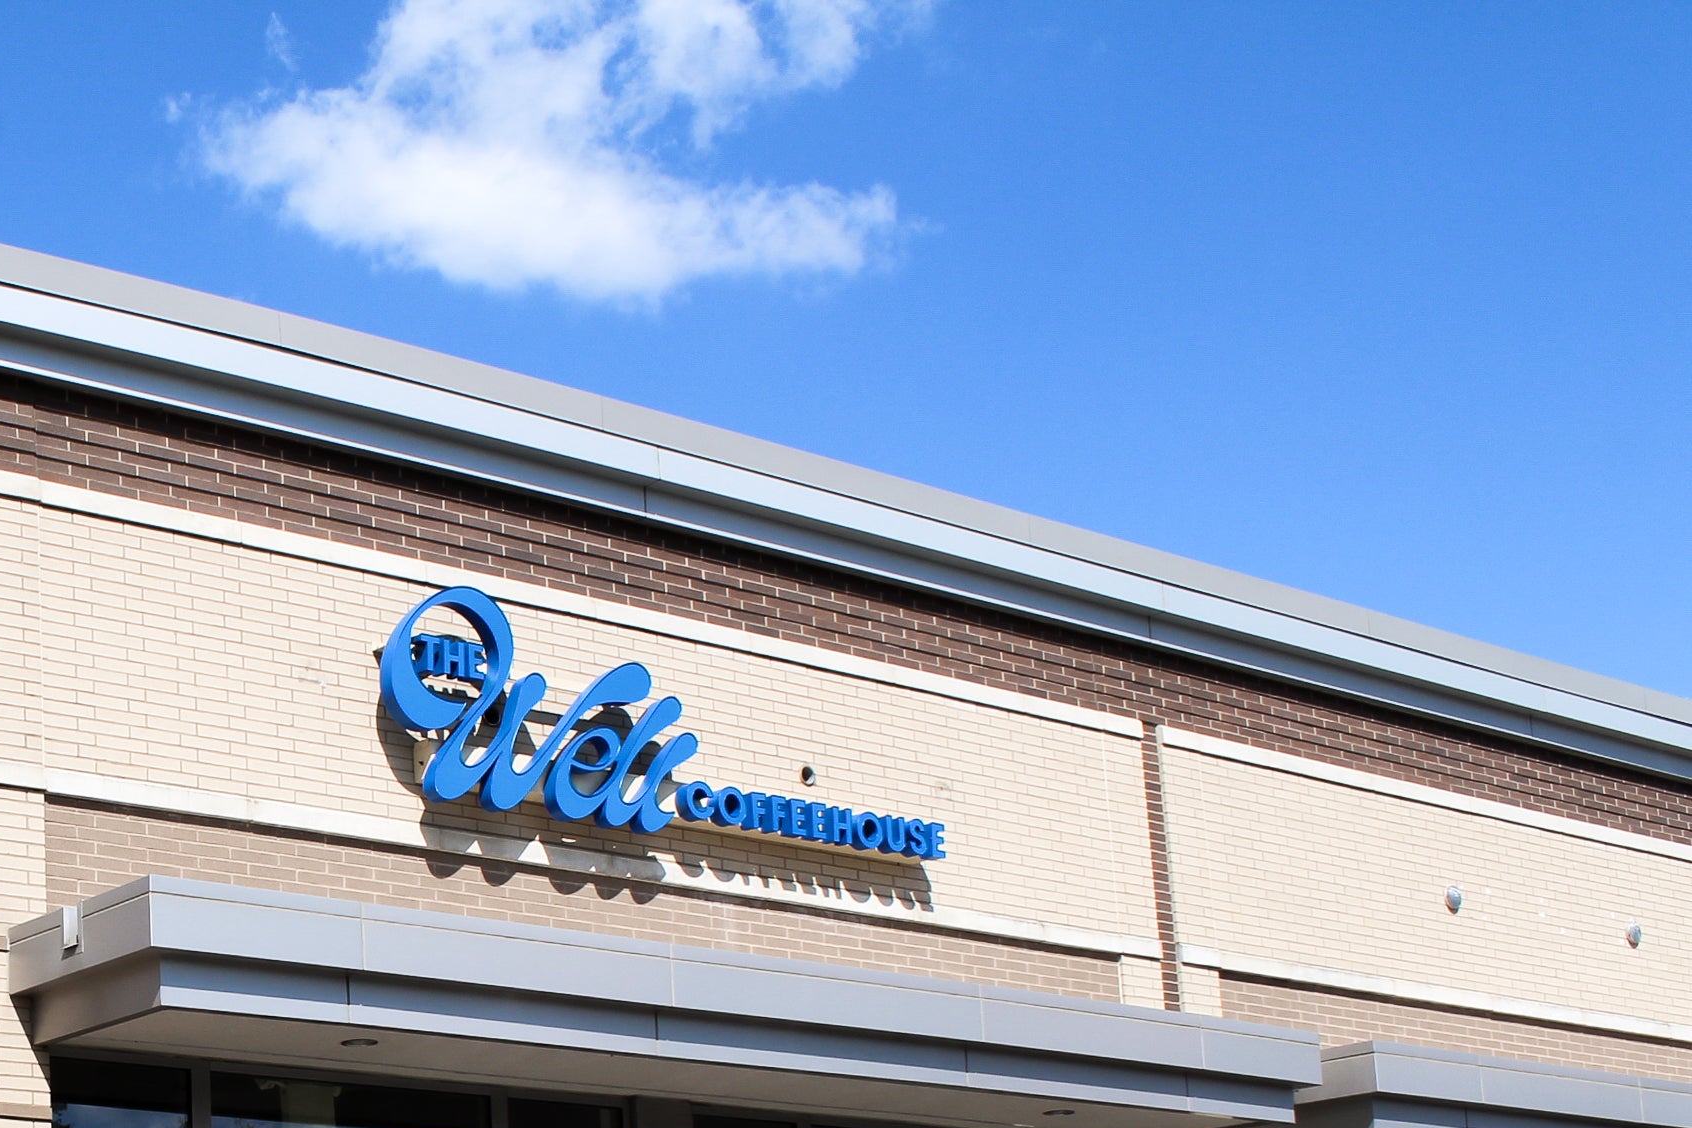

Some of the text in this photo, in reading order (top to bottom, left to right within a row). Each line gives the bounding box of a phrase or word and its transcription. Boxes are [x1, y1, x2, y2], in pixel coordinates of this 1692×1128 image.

[412, 633, 485, 680] THE
[379, 586, 698, 834] Well
[675, 780, 947, 860] COFFEEHOUSE
